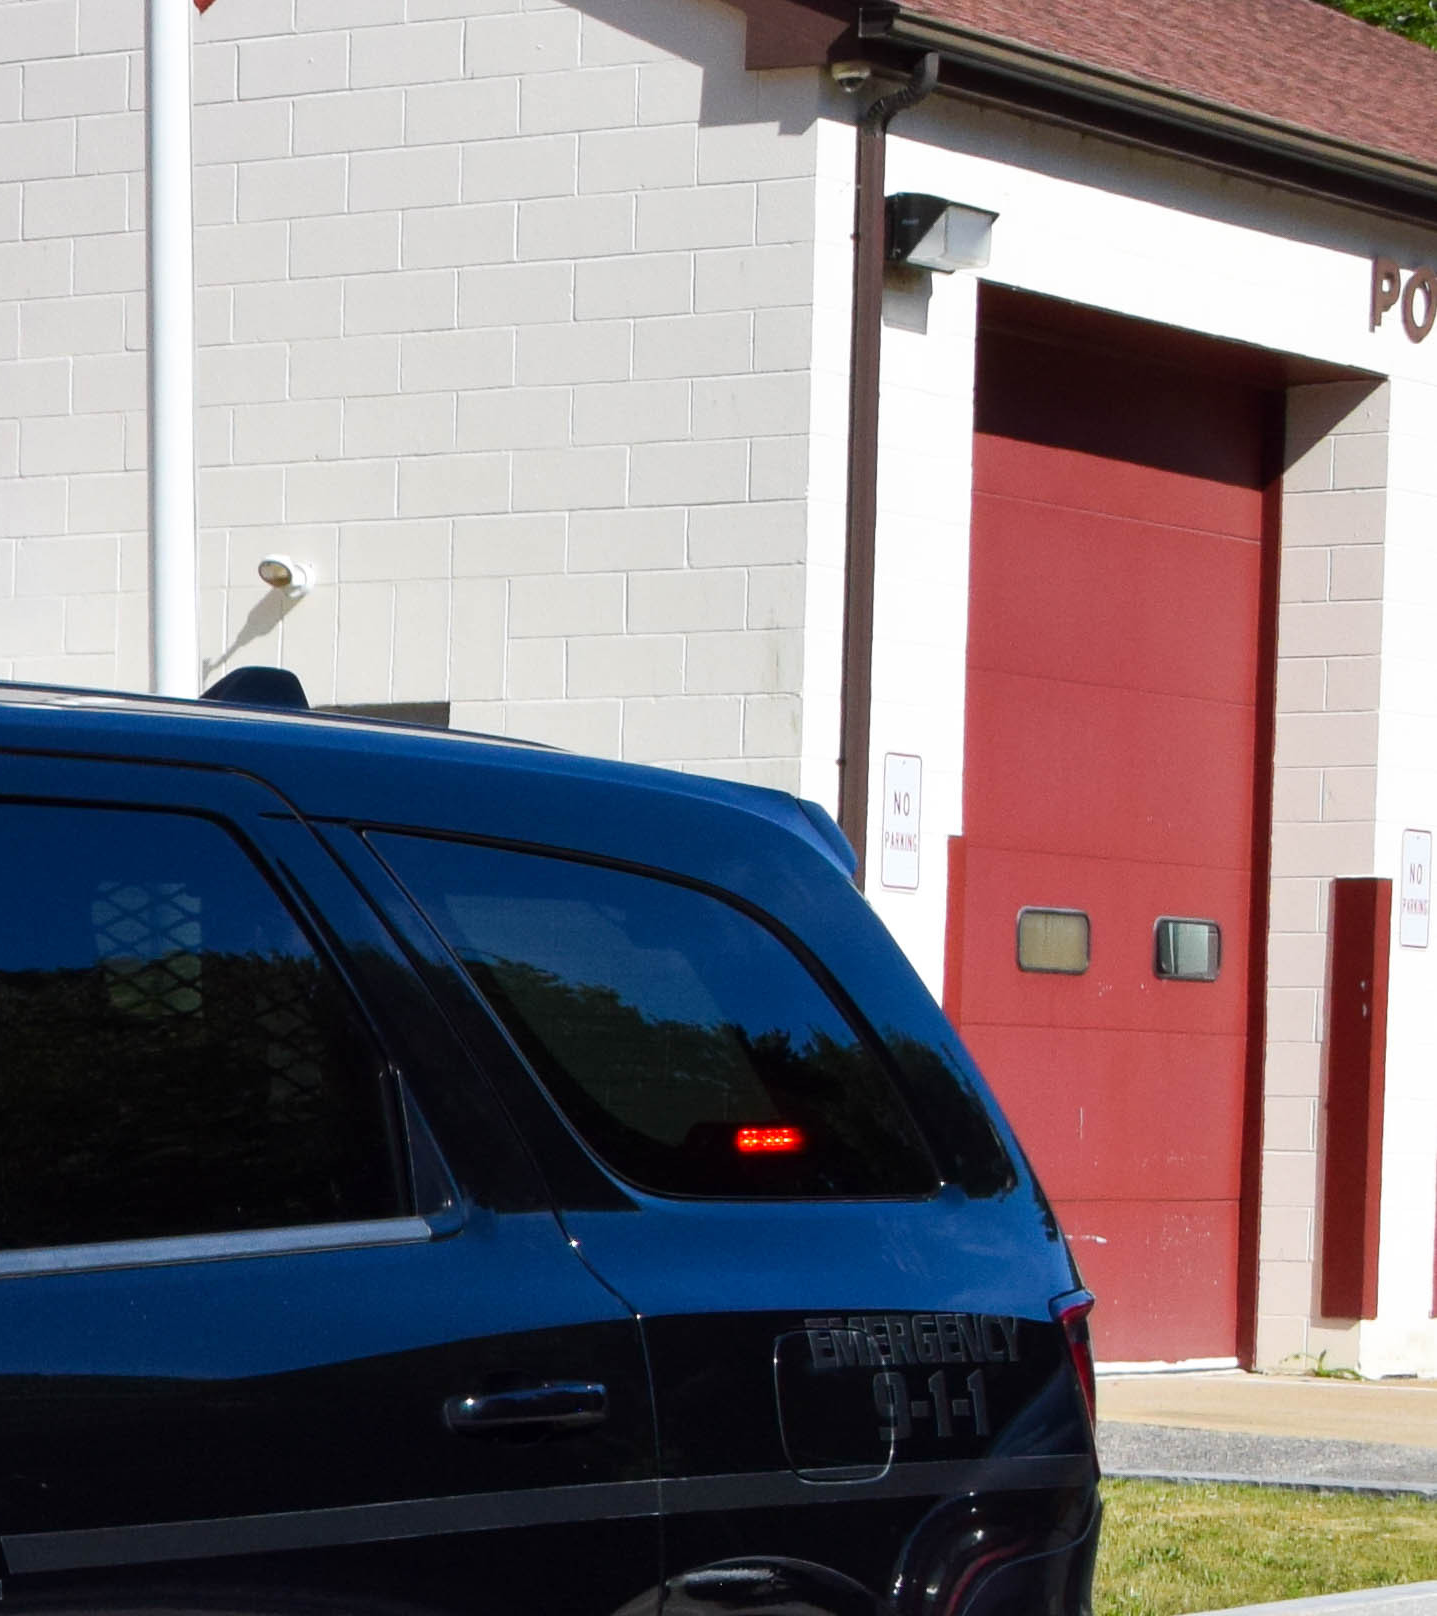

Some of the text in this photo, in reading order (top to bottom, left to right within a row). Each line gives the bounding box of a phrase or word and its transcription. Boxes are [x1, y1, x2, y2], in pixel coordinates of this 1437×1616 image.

[893, 791, 911, 816] NO
[884, 831, 918, 852] PARKING
[1409, 863, 1424, 884] NO
[805, 1314, 1021, 1368] EMERGENCY
[873, 1368, 990, 1441] 9-1-1
